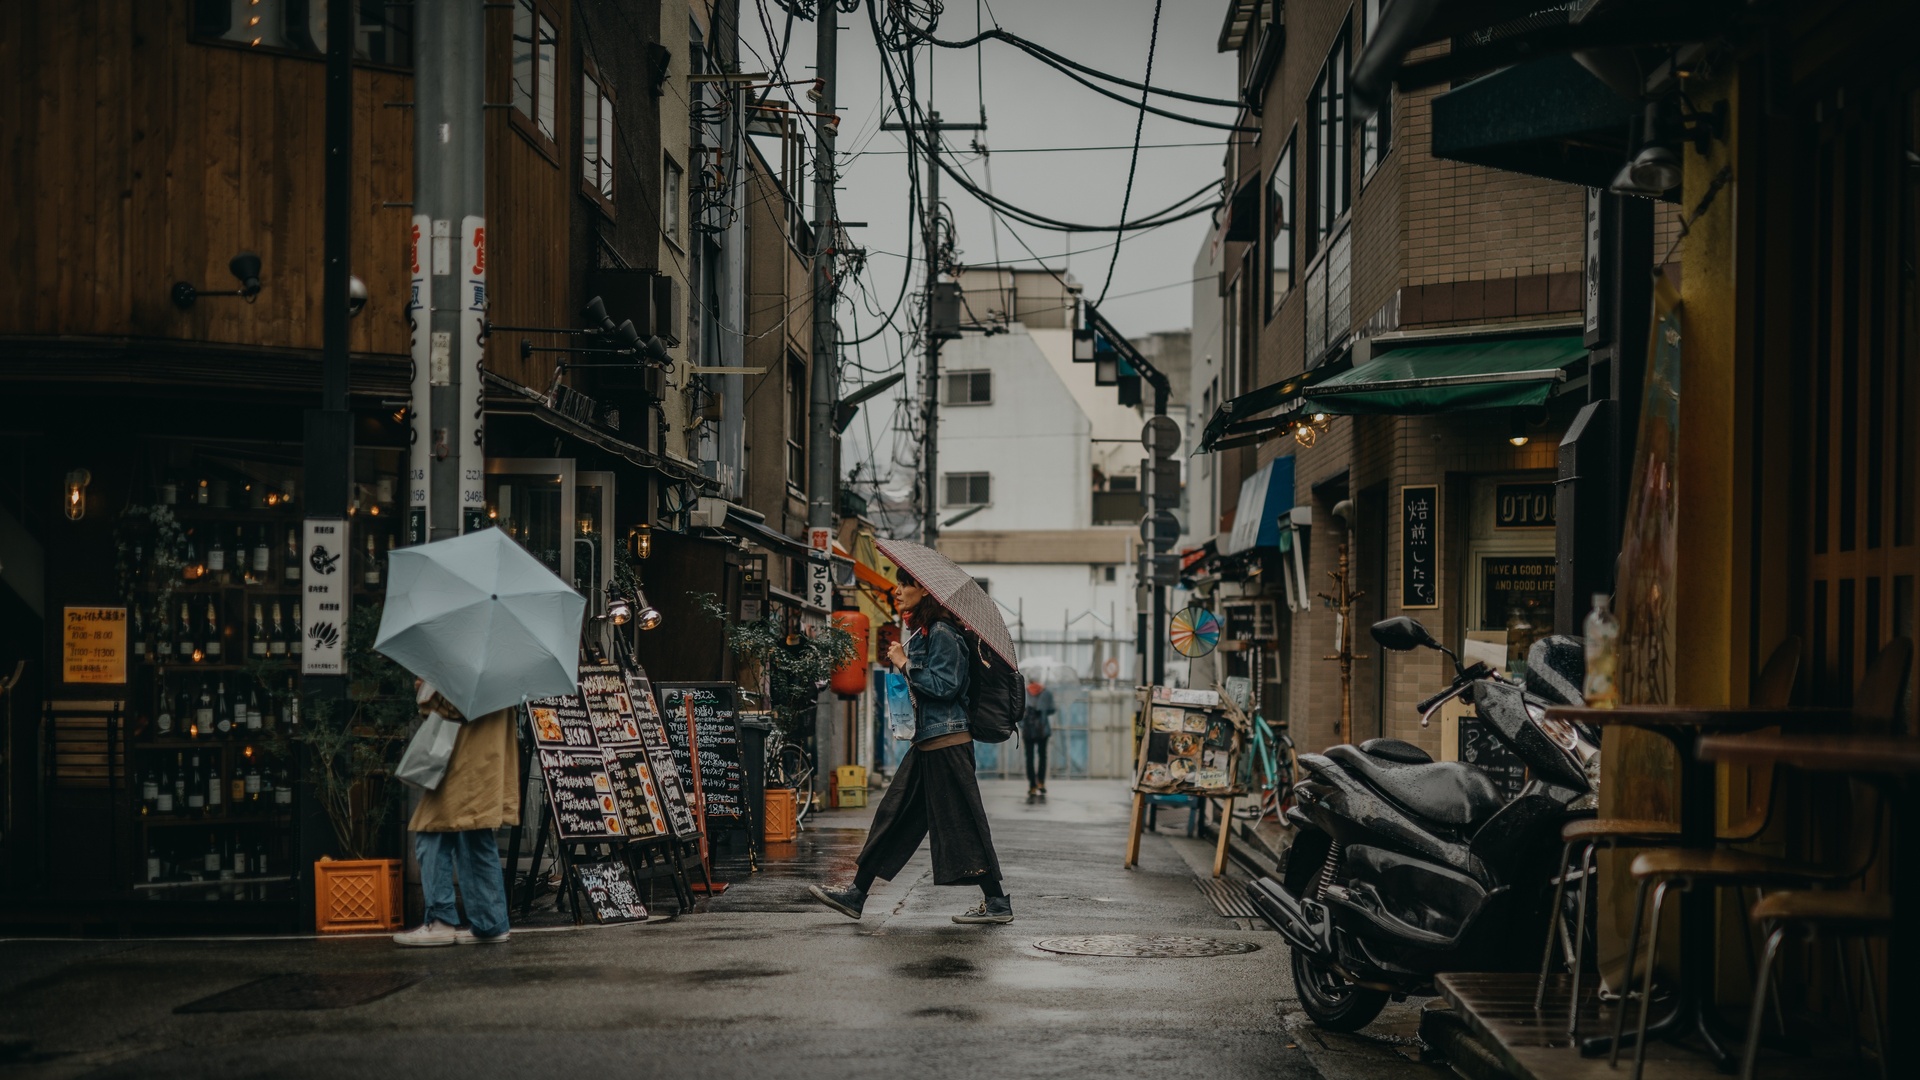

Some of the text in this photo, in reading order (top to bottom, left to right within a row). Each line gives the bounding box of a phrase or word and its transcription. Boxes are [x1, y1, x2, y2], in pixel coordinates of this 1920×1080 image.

[1407, 498, 1429, 598] 焙煎したて
[1512, 564, 1518, 575] A
[1519, 564, 1542, 576] GOOD
[1495, 580, 1510, 591] AND
[1513, 580, 1536, 591] GOOD
